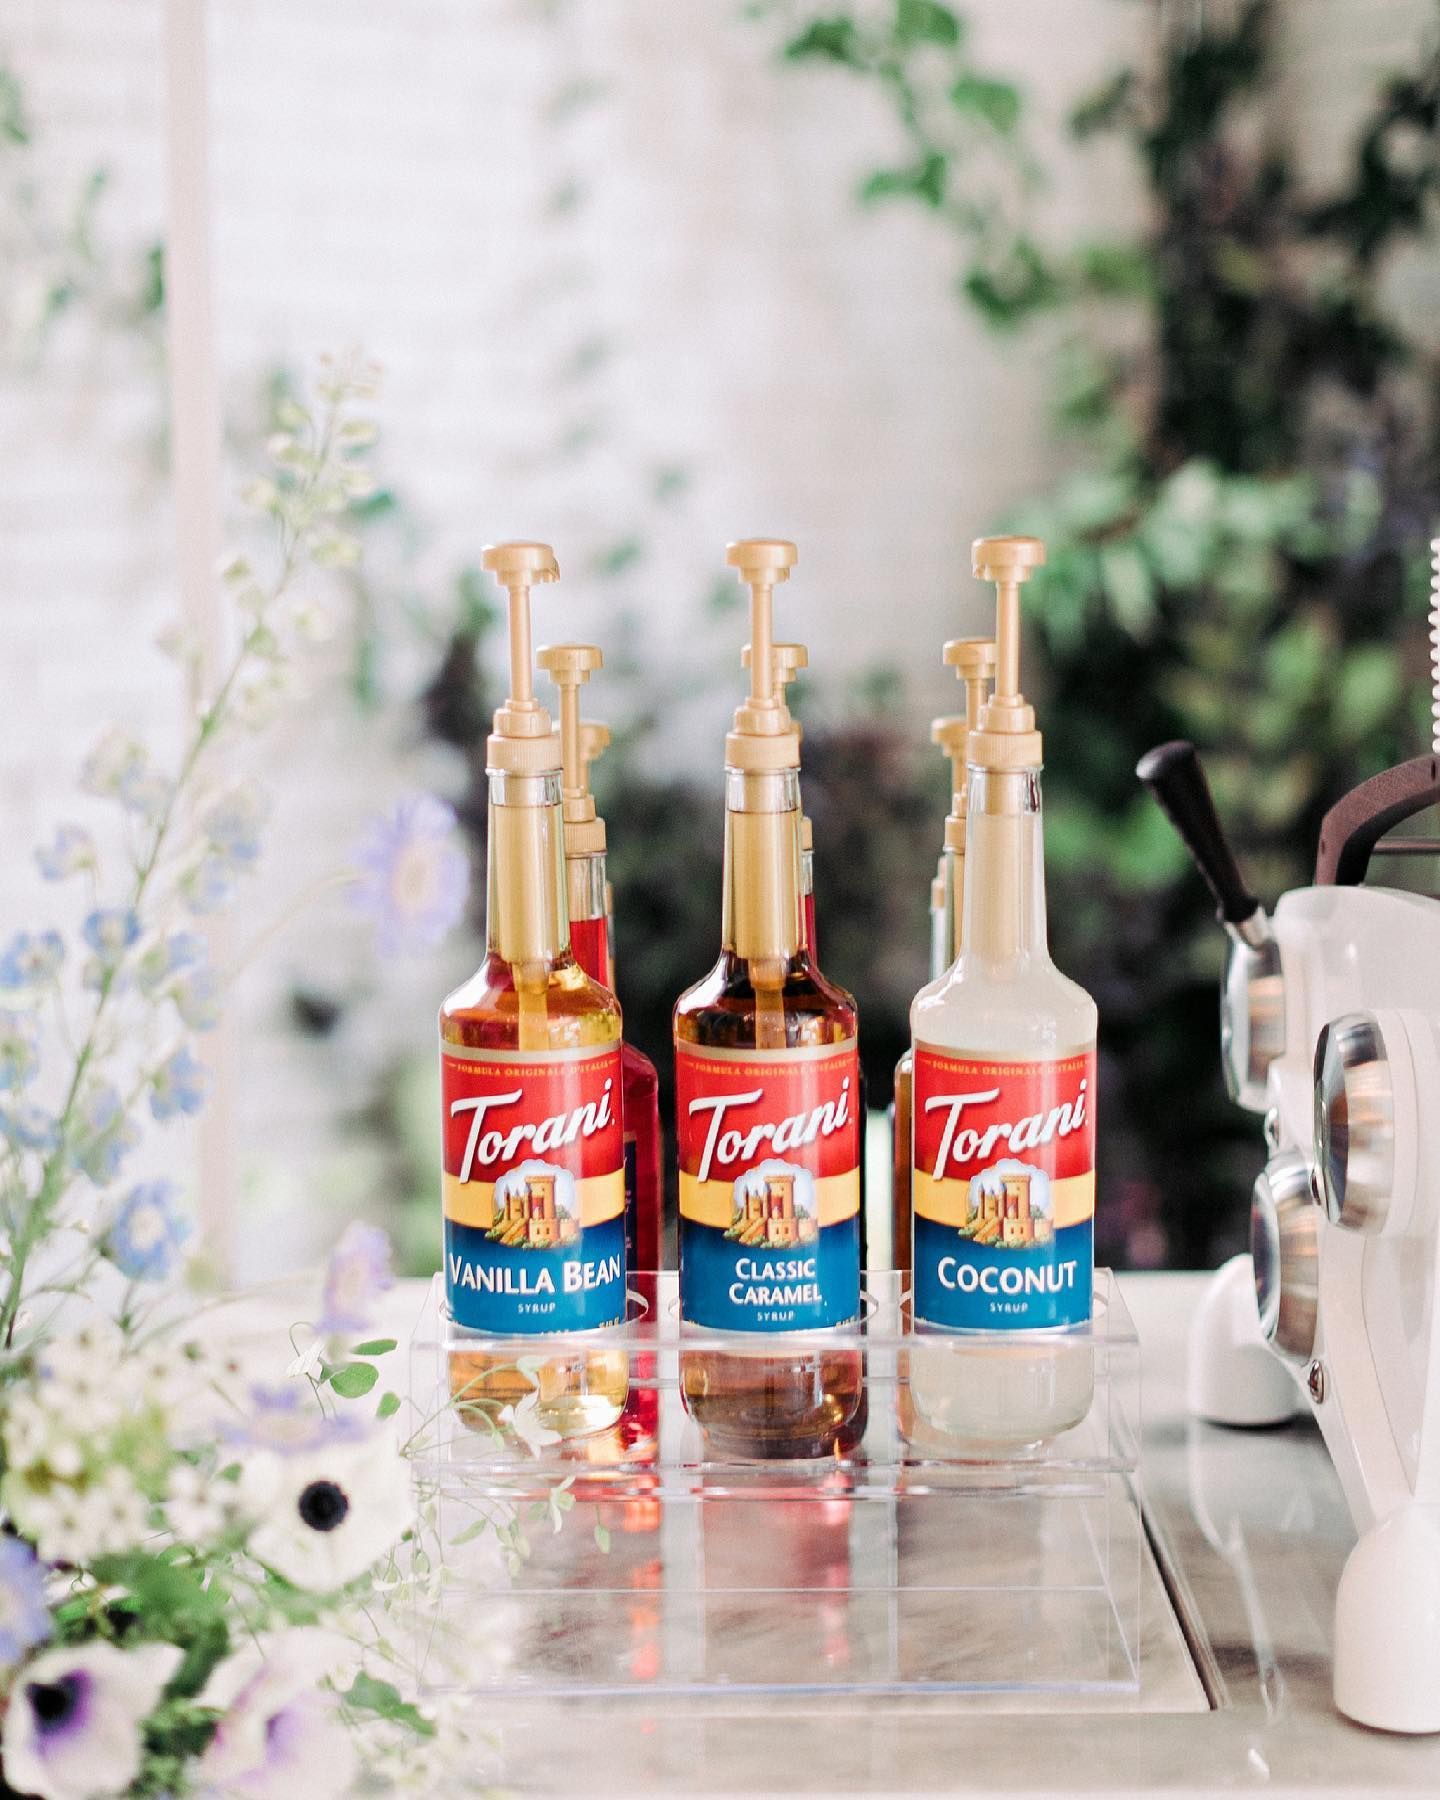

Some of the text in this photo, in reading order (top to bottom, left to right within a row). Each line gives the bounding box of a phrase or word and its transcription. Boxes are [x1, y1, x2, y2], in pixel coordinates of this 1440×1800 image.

[450, 1077, 612, 1185] Torani
[688, 1076, 849, 1183] Torani
[924, 1079, 1088, 1181] Torani
[449, 1253, 621, 1294] VANILLA BEAN
[735, 1258, 816, 1281] CLASSIC
[937, 1256, 1077, 1294] COCONUT
[518, 1303, 556, 1314] SYRUP
[728, 1282, 823, 1307] CARAMEL
[990, 1302, 1029, 1313] SYRUP
[757, 1311, 796, 1322] SYRUP
